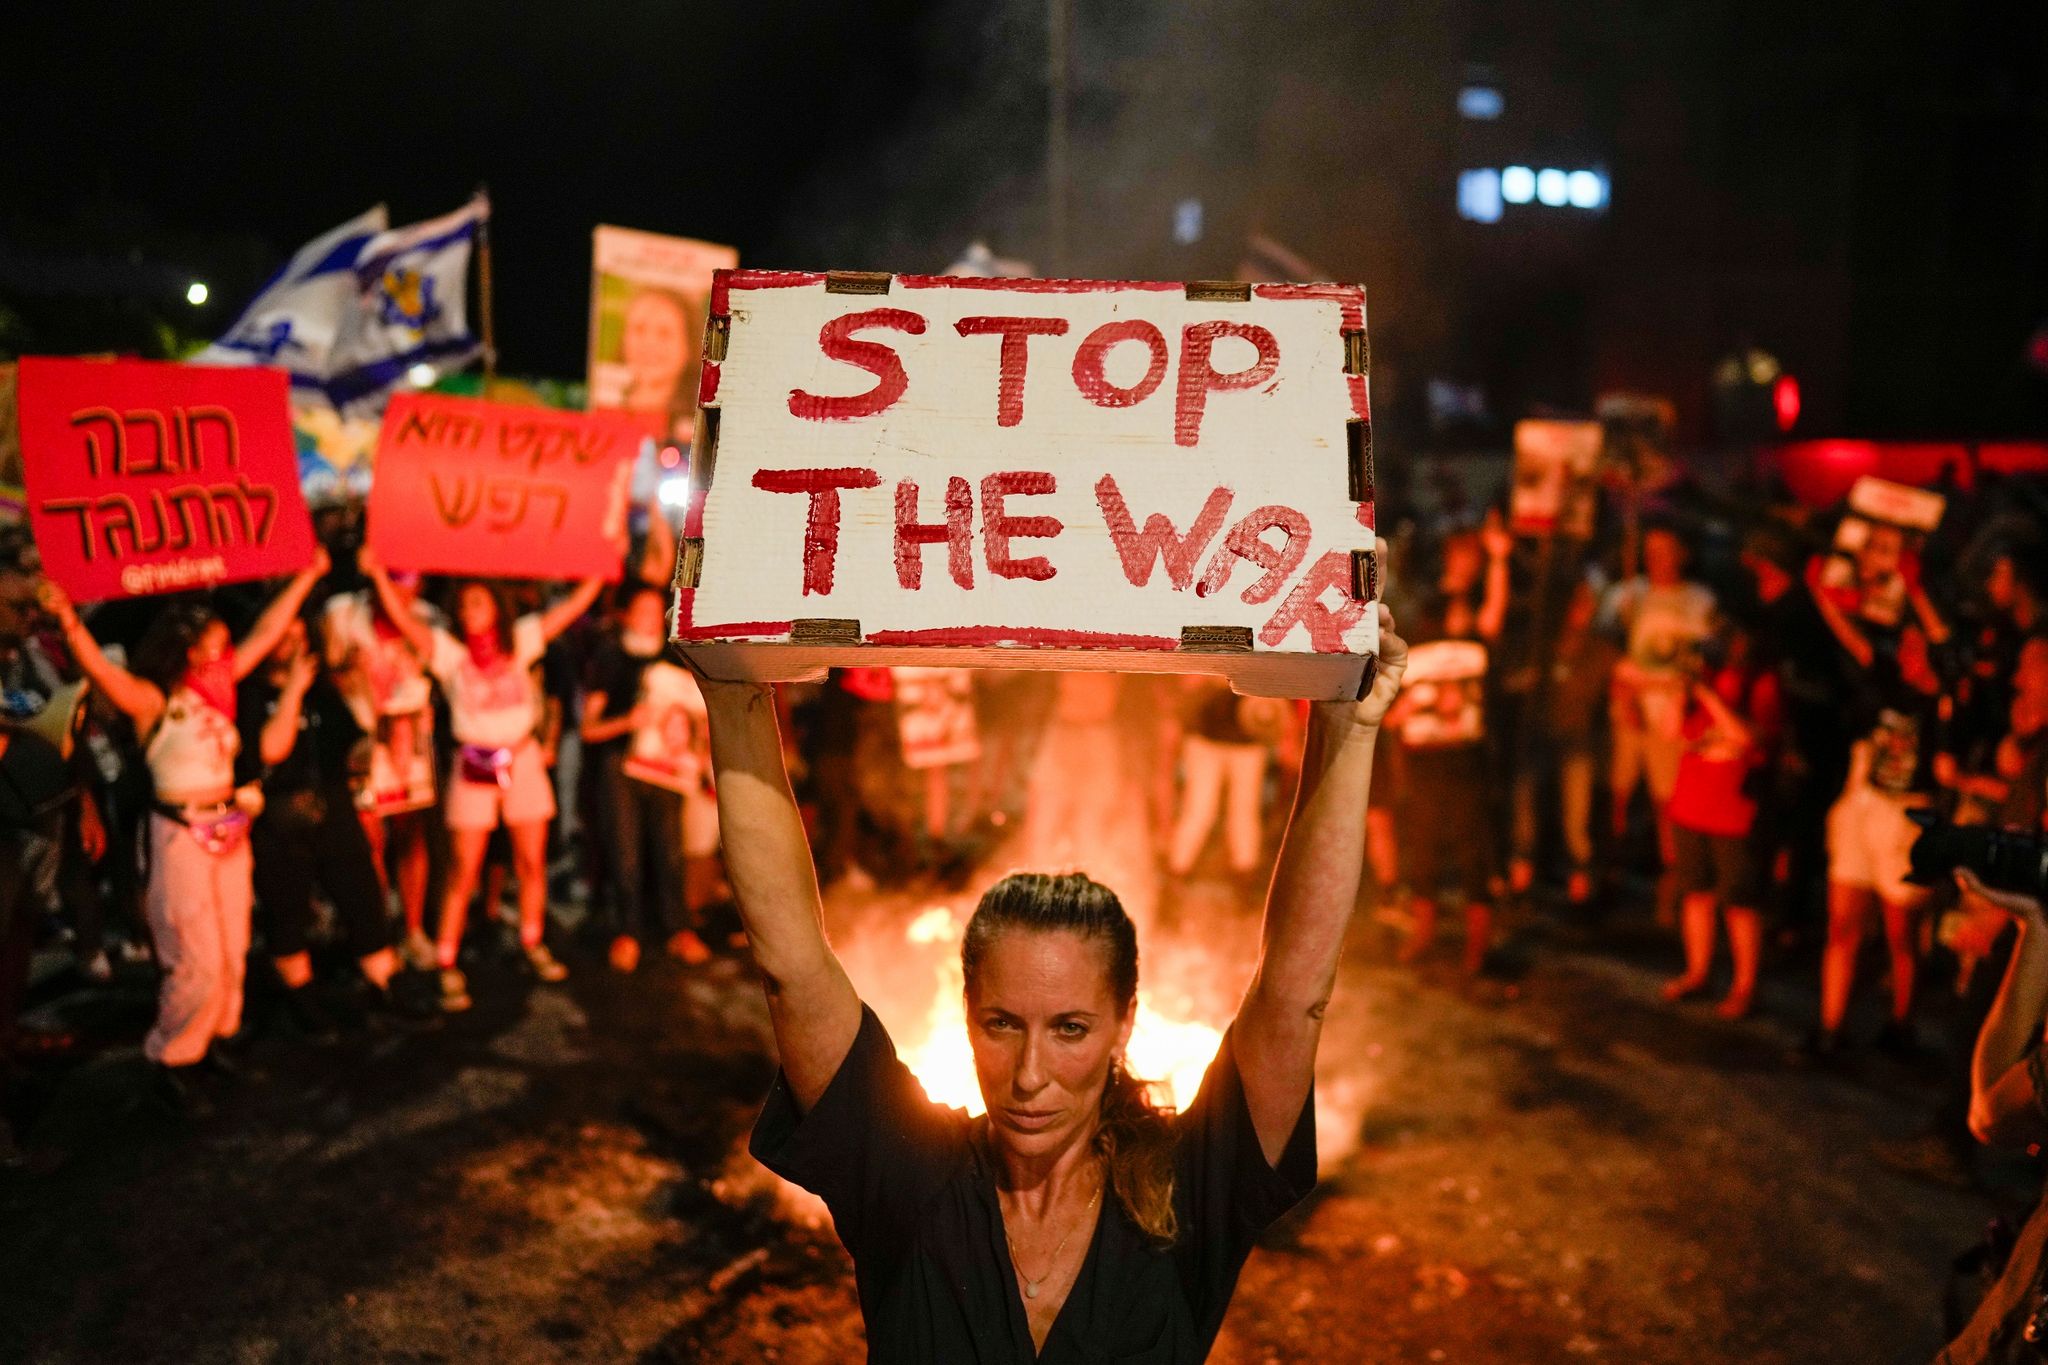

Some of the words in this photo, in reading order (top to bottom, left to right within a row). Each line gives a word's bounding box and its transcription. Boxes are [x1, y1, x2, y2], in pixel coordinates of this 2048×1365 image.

[787, 307, 1281, 447] STOP
[71, 405, 240, 477] חובה
[498, 419, 615, 473] שקט
[43, 473, 279, 563] להתנגד
[430, 470, 568, 536] רפש
[751, 467, 1064, 597] THE
[1094, 472, 1367, 654] WAR
